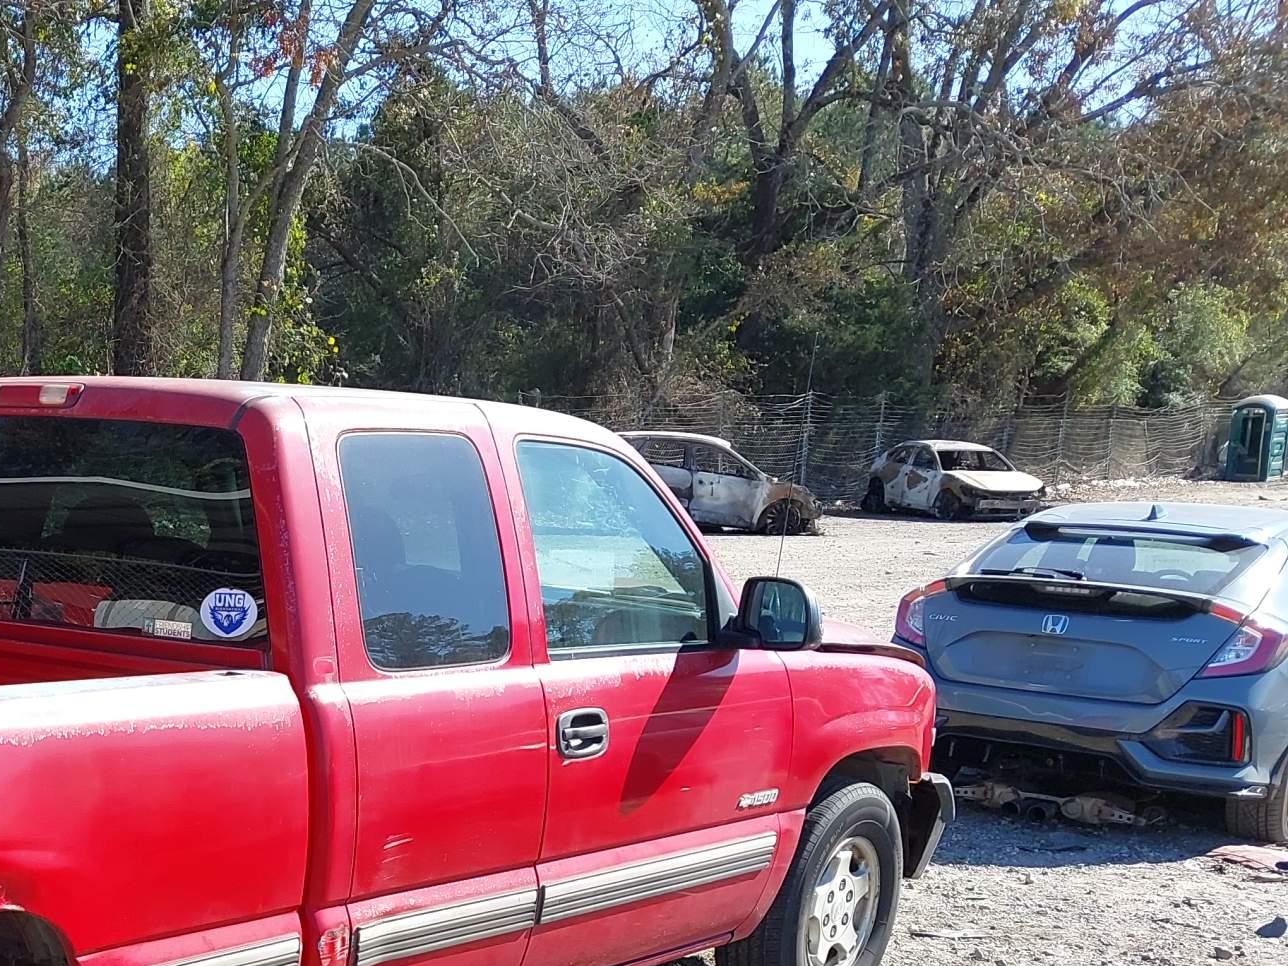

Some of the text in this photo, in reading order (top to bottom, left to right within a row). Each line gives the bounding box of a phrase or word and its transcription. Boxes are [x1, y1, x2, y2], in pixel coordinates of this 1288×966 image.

[215, 594, 244, 607] UNG
[928, 613, 959, 622] CIVIC
[155, 628, 191, 638] STUDENTS
